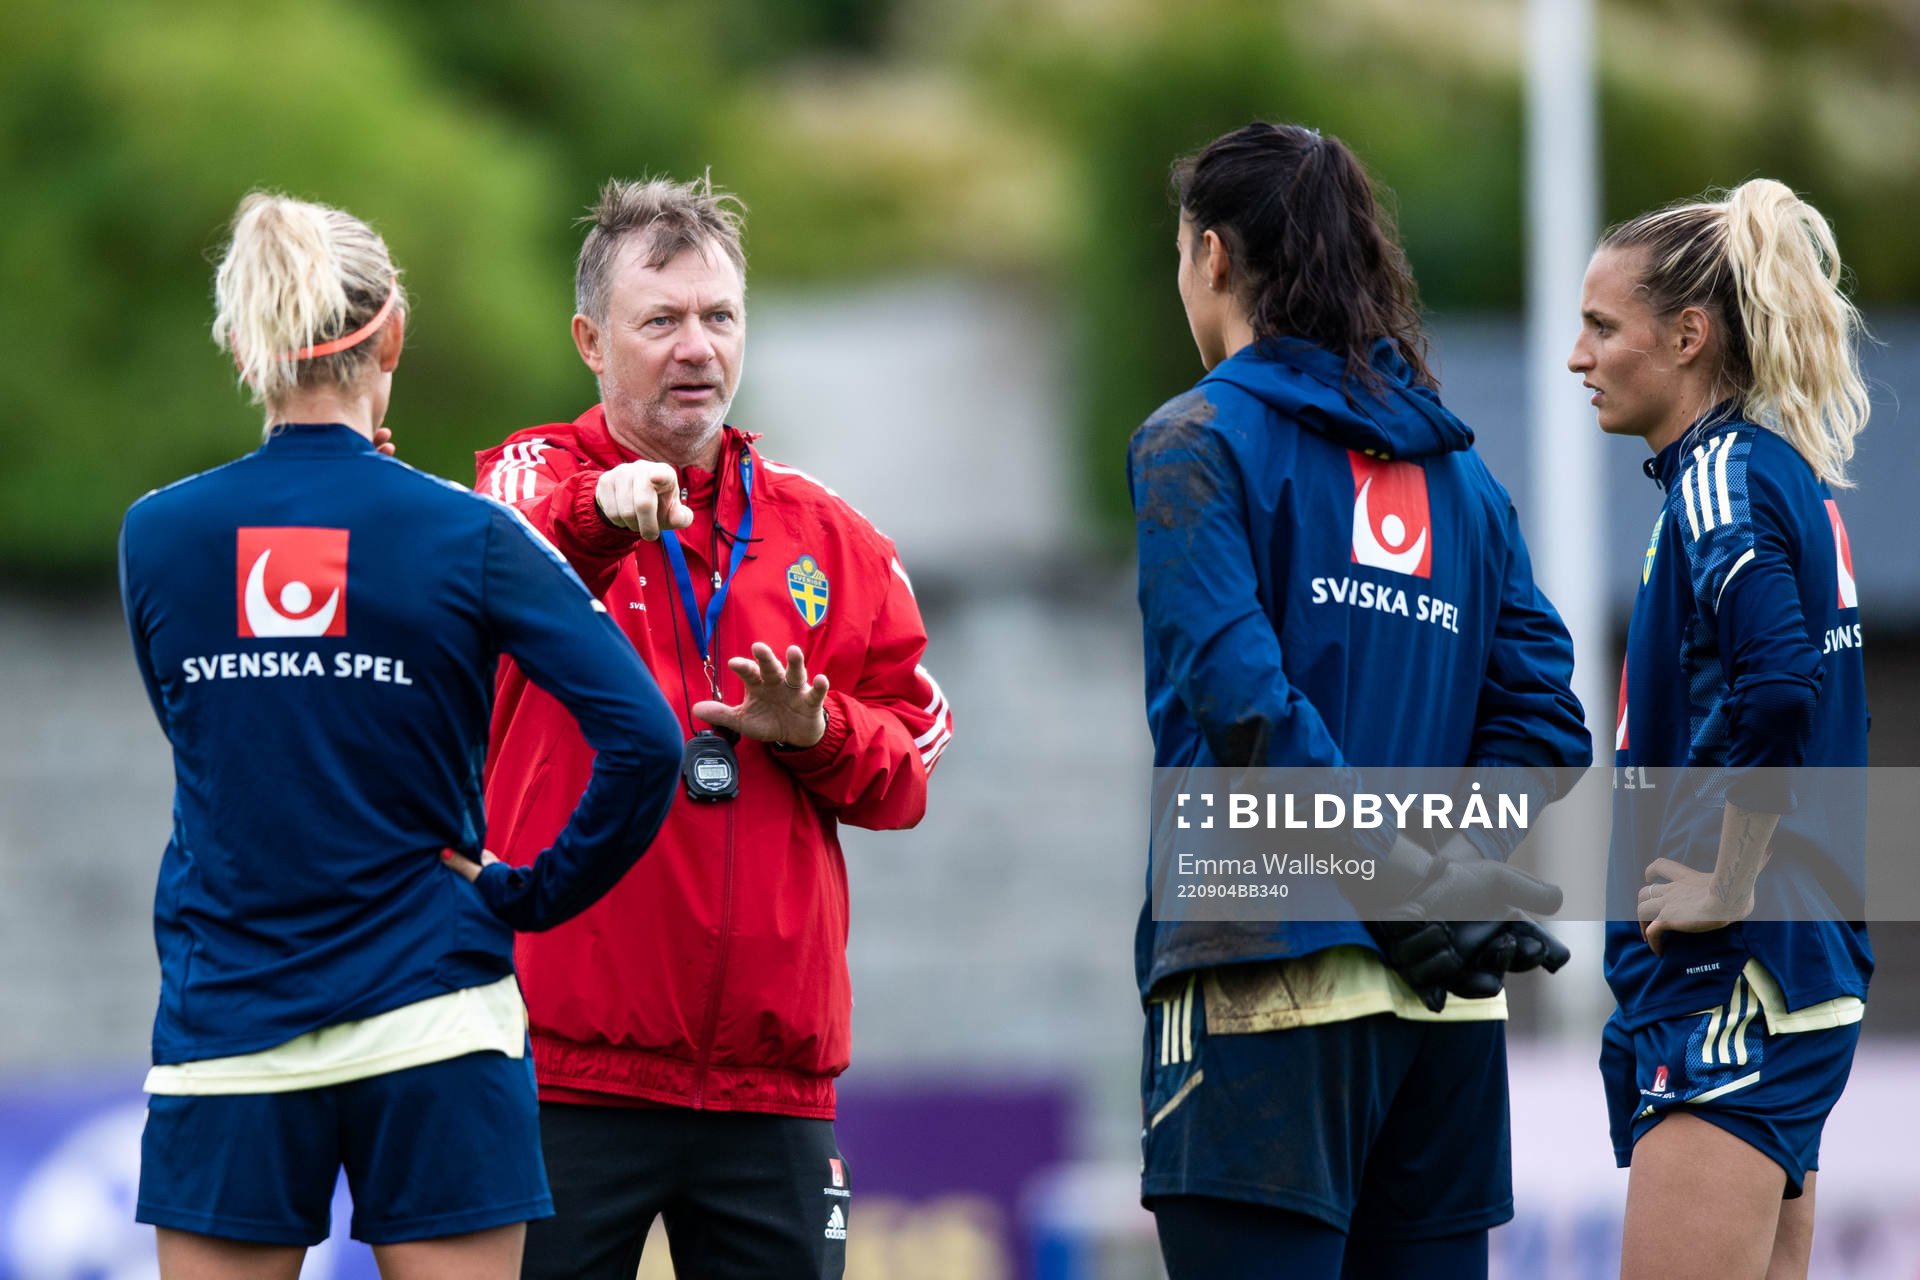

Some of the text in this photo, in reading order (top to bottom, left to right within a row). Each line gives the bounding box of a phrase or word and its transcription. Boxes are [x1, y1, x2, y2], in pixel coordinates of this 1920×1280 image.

[1416, 594, 1459, 634] SPEL
[182, 652, 413, 685] SVENSKA SPEL
